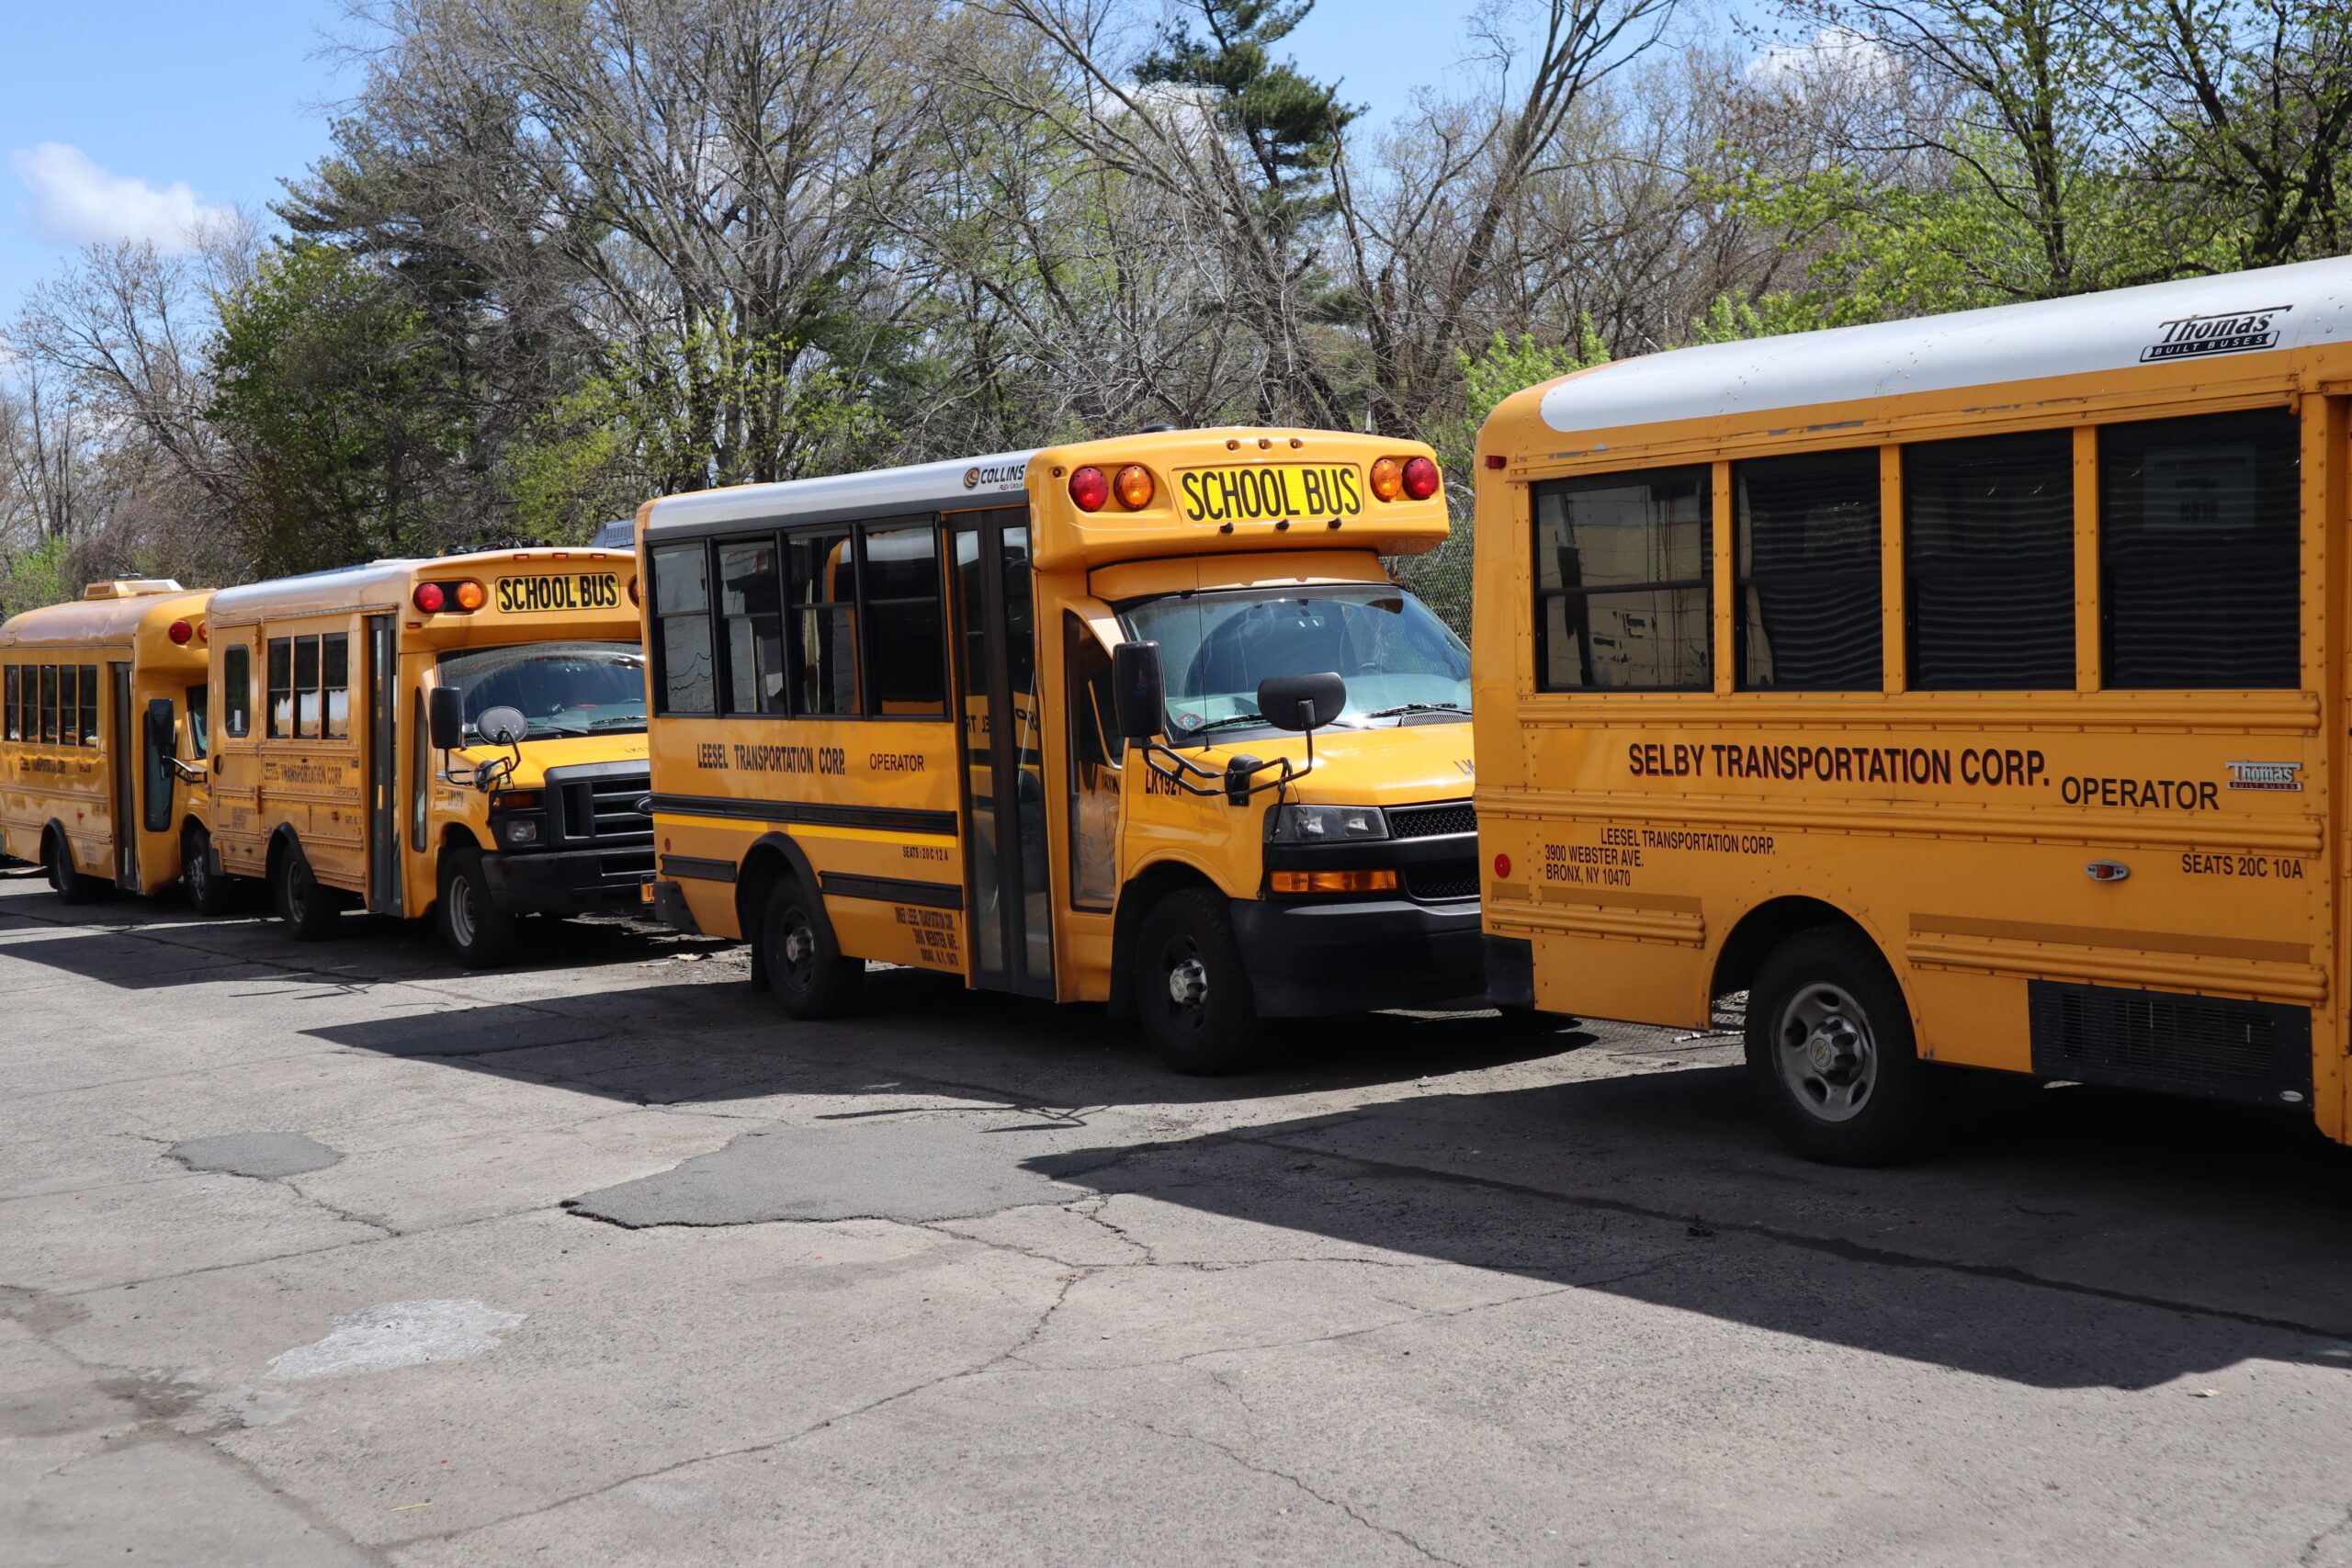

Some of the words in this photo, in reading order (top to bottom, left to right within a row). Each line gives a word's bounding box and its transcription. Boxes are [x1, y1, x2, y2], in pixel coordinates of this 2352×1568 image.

[2159, 305, 2293, 344] Thomas
[2154, 343, 2199, 355] BUILT
[2208, 335, 2264, 350] BUSES
[980, 464, 1026, 484] COLLINS
[1182, 468, 1300, 522] SCHOOL
[1302, 468, 1361, 515] BUS
[499, 576, 577, 611] SCHOOL
[579, 574, 616, 607] BUS
[697, 743, 729, 769] LEESEL
[734, 744, 814, 773] TRANSPORTATION
[819, 747, 845, 775] CORP.
[869, 753, 925, 772] OPERATOR
[1629, 743, 1705, 777] SELBY
[1712, 744, 1951, 785] TRANSPORTATION
[1960, 748, 2050, 786] CORP.
[2226, 761, 2301, 783] Thomas
[280, 764, 326, 784] TRANSPORTATION
[2061, 776, 2221, 811] OPERATOR
[1600, 827, 1640, 847] LEESEL
[1642, 829, 1739, 853] TRANSPORTATION
[1742, 835, 1776, 855] CORP.
[1544, 844, 1566, 862] 3900
[1568, 846, 1618, 865] WEBSTER
[1621, 850, 1645, 867] AVE.
[2182, 853, 2233, 875] SEATS
[2238, 857, 2267, 877] 20C
[2273, 859, 2303, 879] 10A
[1545, 863, 1584, 886] BRONX,
[1586, 866, 1600, 885] NY
[1602, 867, 1631, 886] 10470
